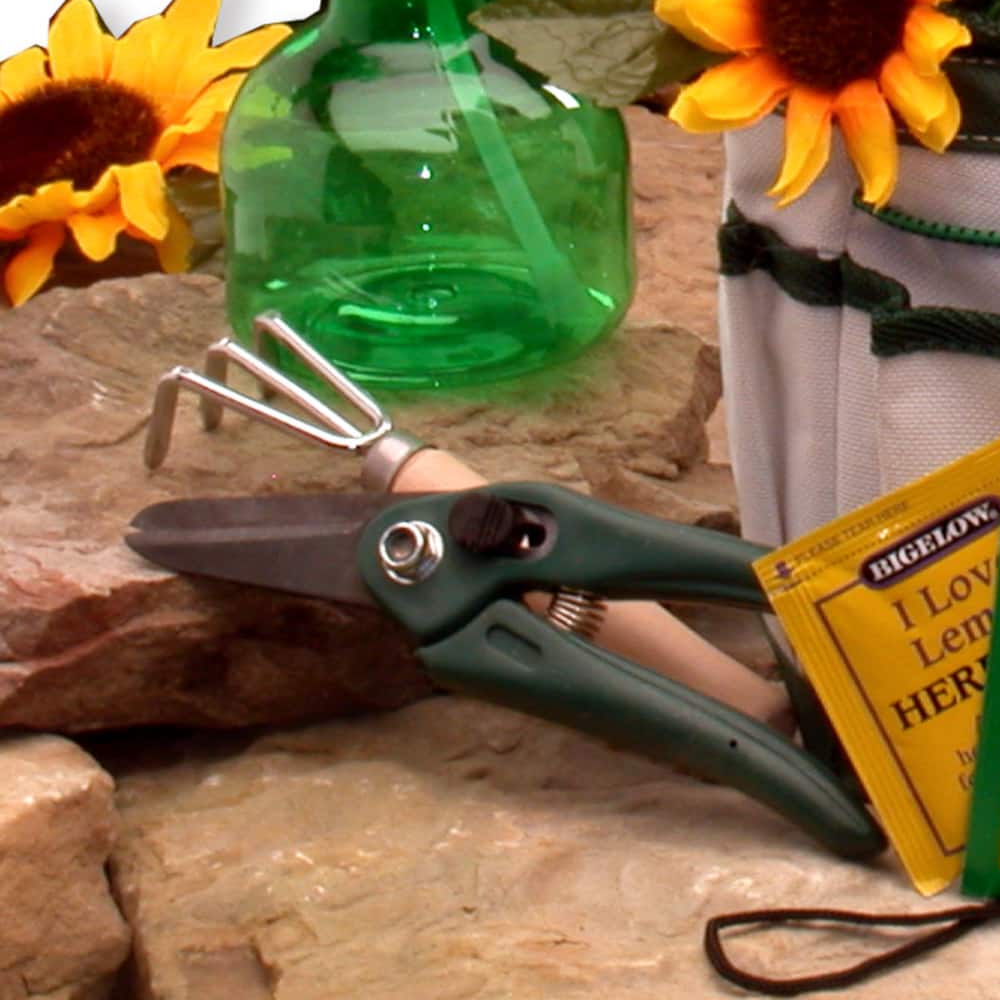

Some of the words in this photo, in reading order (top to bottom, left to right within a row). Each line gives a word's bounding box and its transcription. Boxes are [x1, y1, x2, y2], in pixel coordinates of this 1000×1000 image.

[868, 501, 993, 582] BIGELOW
[891, 599, 915, 631] I
[918, 558, 993, 617] Lov
[911, 608, 992, 669] Lem
